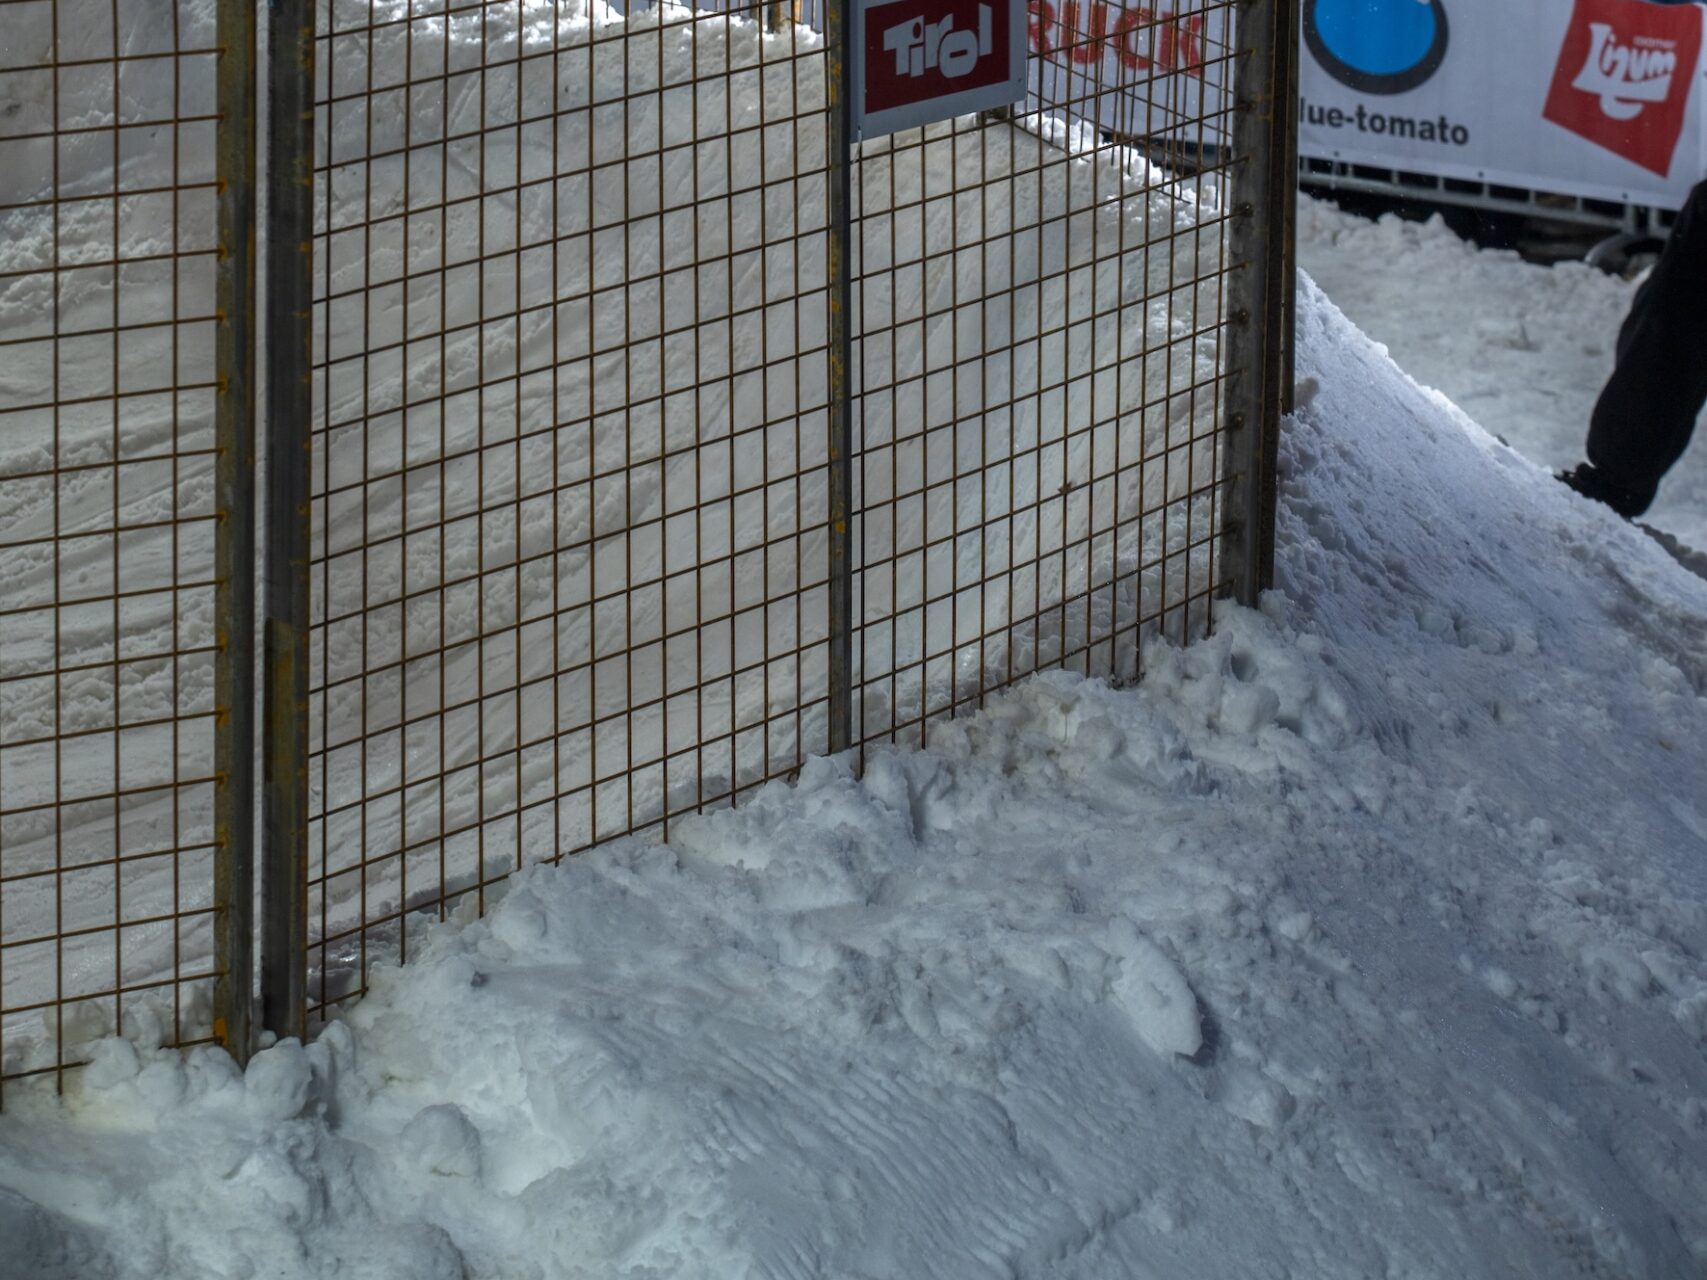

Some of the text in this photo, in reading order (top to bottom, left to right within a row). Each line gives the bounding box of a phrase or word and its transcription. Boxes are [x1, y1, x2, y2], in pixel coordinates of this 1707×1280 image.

[883, 2, 993, 79] Tirol
[1028, 0, 1201, 78] RUCK
[1299, 97, 1470, 146] lue-tomato
